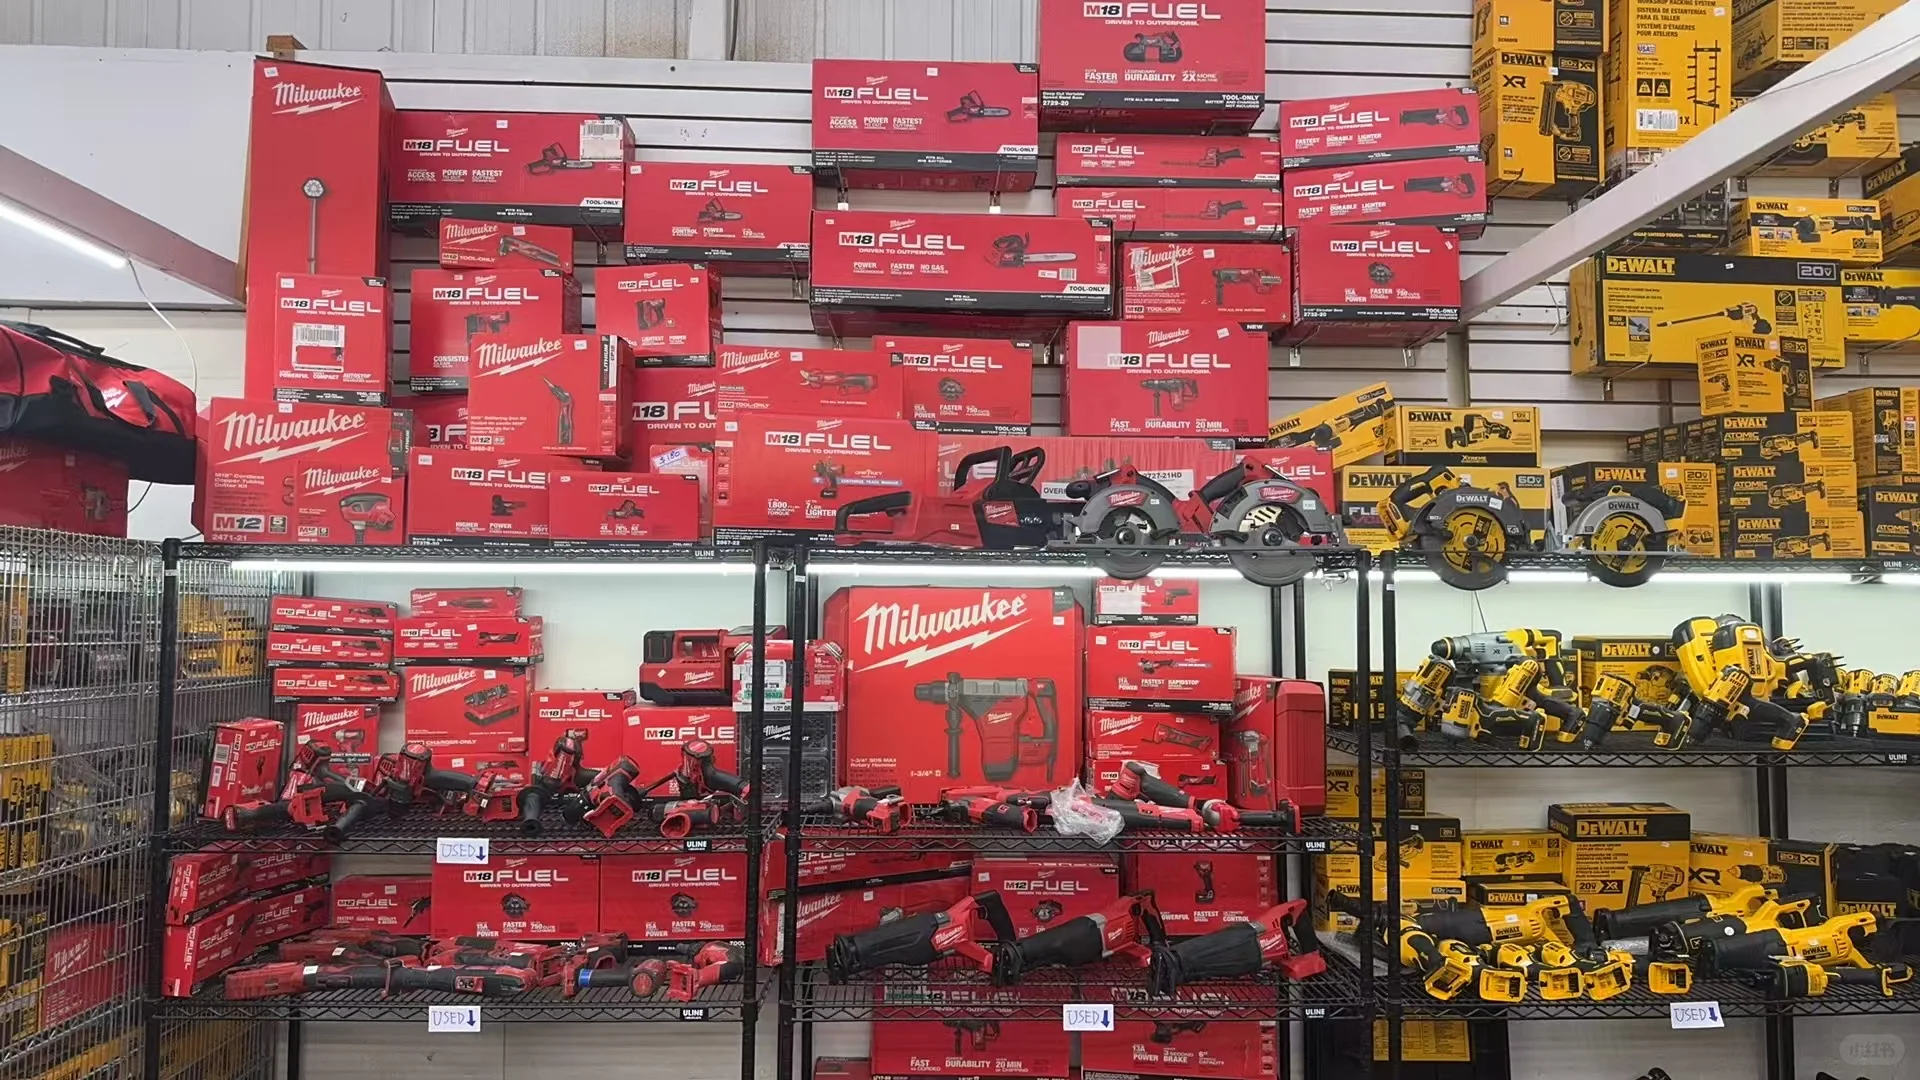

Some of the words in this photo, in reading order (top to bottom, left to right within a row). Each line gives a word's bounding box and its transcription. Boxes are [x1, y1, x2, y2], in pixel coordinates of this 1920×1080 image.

[1086, 5, 1120, 15] M18
[1127, 4, 1220, 19] FUEL
[1125, 73, 1176, 81] DURABILITY
[1182, 74, 1196, 82] 2X
[1503, 75, 1526, 88] XR
[272, 82, 361, 105] Milwaukee
[827, 89, 852, 97] M18
[858, 88, 928, 100] FUEL
[1292, 118, 1317, 126] M18
[1322, 112, 1389, 125] FUEL
[405, 141, 431, 150] M18
[436, 140, 509, 152] FUEL
[701, 181, 768, 192] FUEL
[1296, 186, 1320, 196] M18
[1325, 180, 1394, 194] FUEL
[444, 224, 498, 239] Milwaukee
[841, 235, 872, 244] M18
[879, 234, 964, 249] FUEL
[1332, 242, 1357, 251] M18
[1362, 241, 1430, 252] FUEL
[1607, 258, 1675, 273] DEWALT
[435, 290, 461, 298] M18
[466, 288, 539, 300] FUEL
[283, 300, 308, 308] M18
[313, 300, 381, 312] FUEL
[1148, 329, 1190, 344] Milwaukee
[474, 338, 562, 369] Milwaukee
[721, 349, 780, 367] Milwaukee
[904, 356, 928, 364] M18
[934, 355, 1003, 368] FUEL
[1109, 355, 1140, 365] M18
[1146, 354, 1231, 368] FUEL
[1737, 354, 1755, 367] XR
[216, 409, 368, 451] Milwaukee
[1724, 432, 1759, 440] ATOMIC
[768, 434, 798, 444] M18
[806, 433, 891, 448] FUEL
[667, 450, 680, 461] 180
[301, 466, 380, 489] Milwaukee
[611, 485, 659, 494] FUEL
[1734, 481, 1768, 489] ATOMIC
[1608, 502, 1640, 510] DEWALT
[215, 517, 262, 529] M12
[1876, 524, 1909, 533] ATOMIC
[853, 592, 1027, 655] Milwaukee
[1143, 641, 1198, 649] FUEL
[412, 669, 476, 693] Milwaukee
[684, 671, 714, 682] Milwaukee
[303, 709, 358, 727] Milwaukee
[562, 709, 612, 718] FUEL
[1100, 715, 1142, 732] Milwaukee
[257, 739, 281, 748] FUEL
[1328, 781, 1349, 792] XR
[1577, 821, 1647, 835] DEWALT
[441, 843, 474, 856] USED
[467, 873, 492, 881] M18
[497, 870, 568, 882] FUEL
[635, 872, 660, 880] M18
[666, 869, 736, 881] FUEL
[1689, 868, 1721, 885] XR
[1007, 881, 1026, 889] M12
[1030, 880, 1088, 891] FUEL
[265, 907, 297, 920] FUEL
[936, 925, 963, 943] Milwaukee
[1260, 934, 1282, 949] Milwaukee
[432, 1011, 464, 1025] USED
[1066, 1009, 1100, 1025] USED
[1674, 1009, 1706, 1022] USED
[911, 1059, 929, 1067] FAST
[946, 1060, 990, 1068] DURABILITY
[1133, 1054, 1158, 1062] POWER
